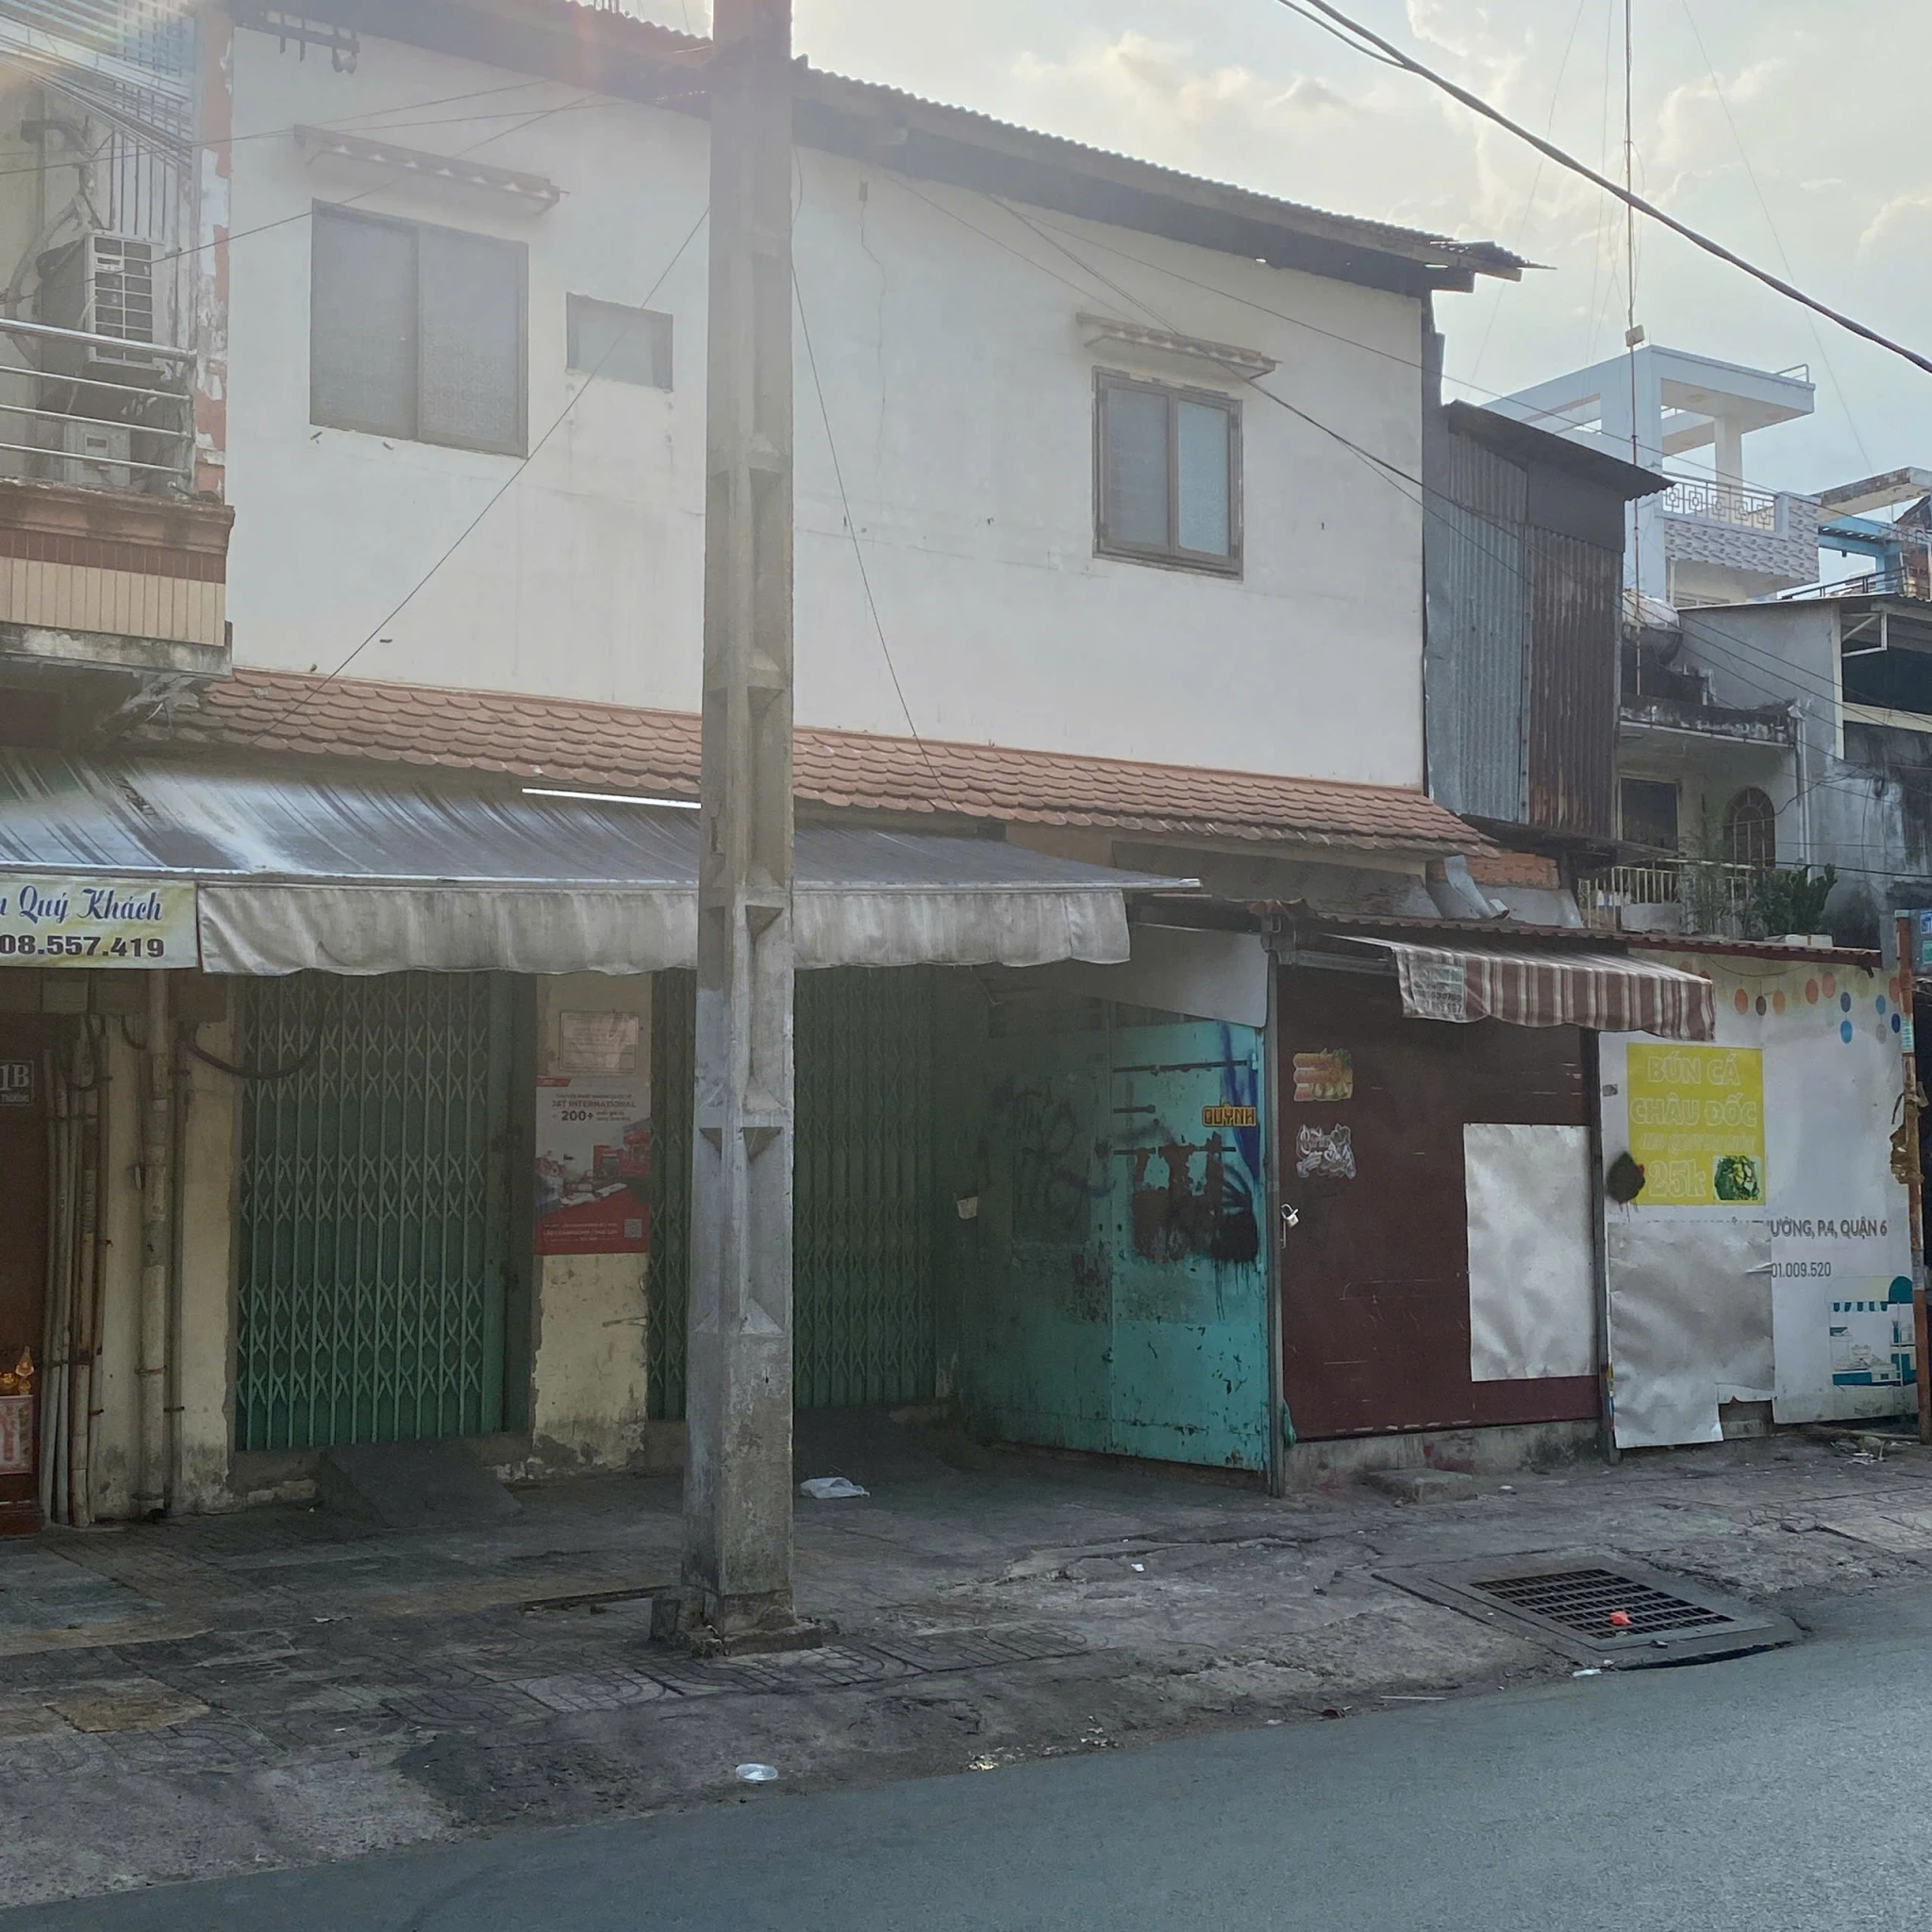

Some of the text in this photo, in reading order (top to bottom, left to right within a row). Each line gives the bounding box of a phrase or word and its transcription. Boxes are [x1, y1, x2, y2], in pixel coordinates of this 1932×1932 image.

[19, 885, 70, 924] Quý
[77, 888, 163, 922] Khách
[0, 934, 164, 958] 08.557.419
[1648, 1050, 1741, 1087] BÚN CÁ
[561, 1109, 594, 1122] 200+
[1203, 1102, 1256, 1126] QUỲNH
[1630, 1091, 1757, 1127] CHÂU ĐỐC
[1840, 1215, 1878, 1240] QUẬN
[1879, 1219, 1889, 1237] 6
